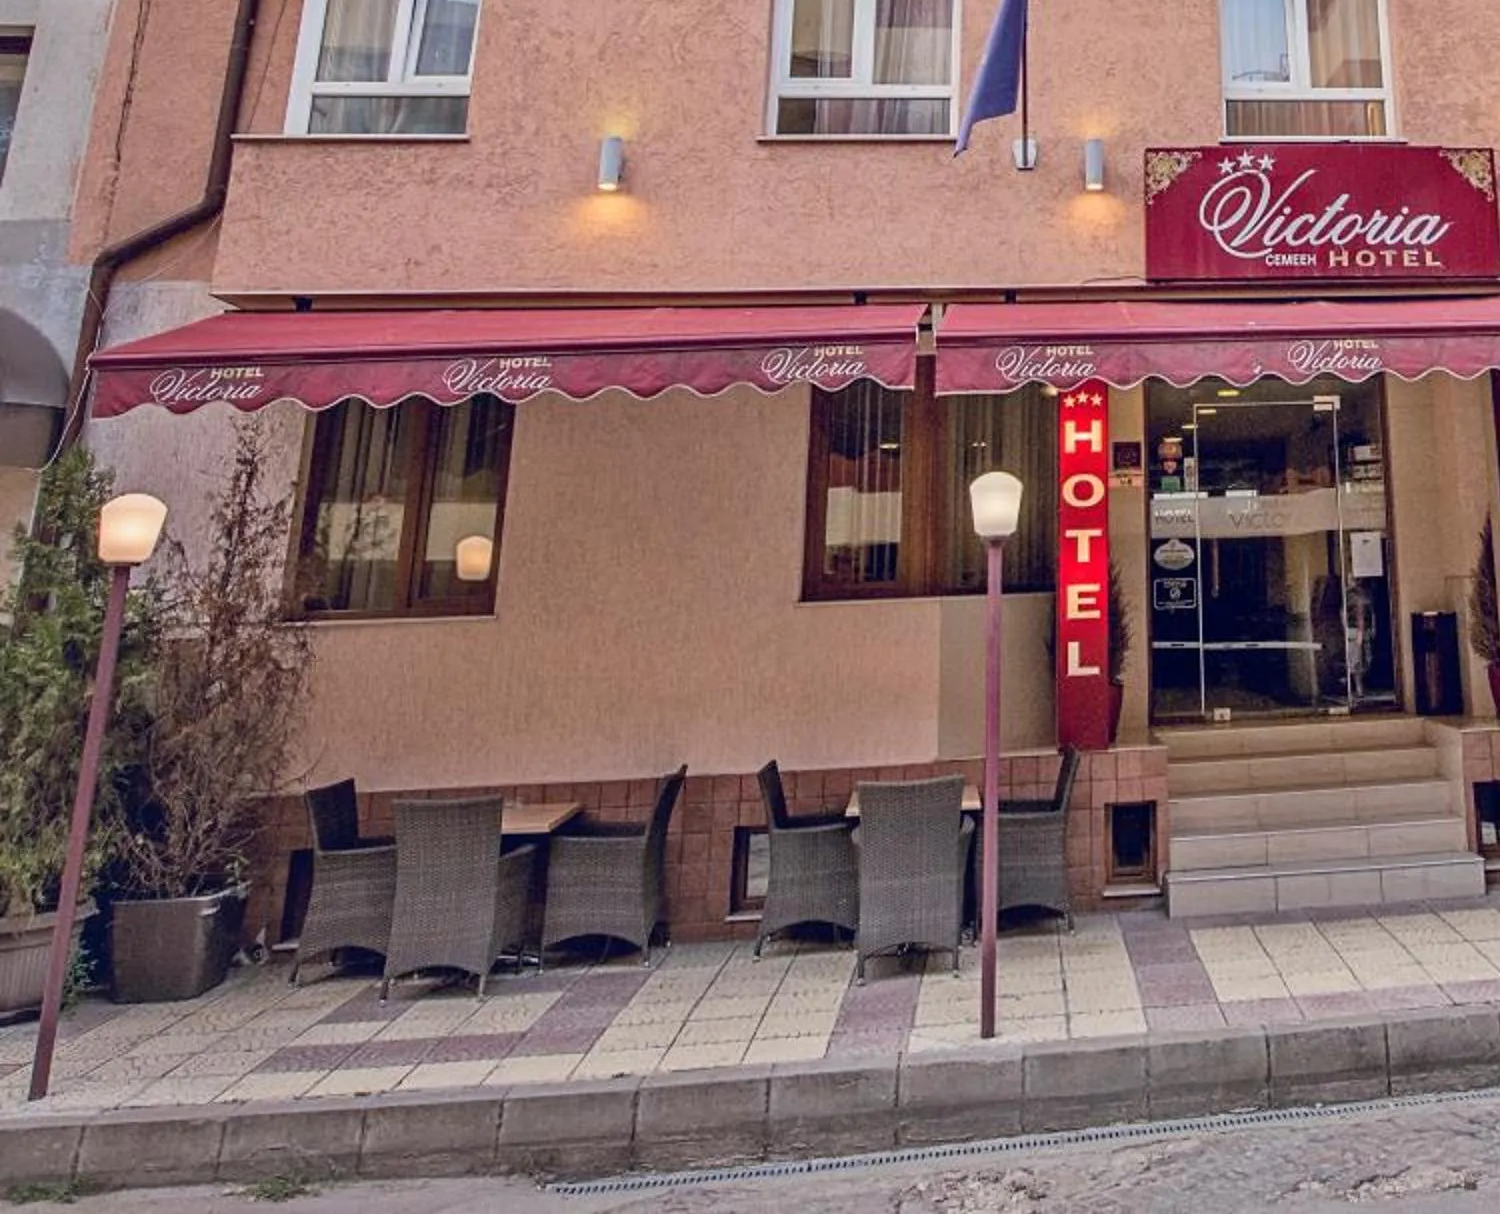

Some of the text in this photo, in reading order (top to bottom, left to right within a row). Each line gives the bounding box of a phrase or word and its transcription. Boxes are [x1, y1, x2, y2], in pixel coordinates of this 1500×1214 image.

[1200, 169, 1455, 258] Victoria
[1328, 250, 1443, 267] HOTEL
[500, 356, 552, 368] HOTEL
[761, 348, 866, 384] Victoria
[814, 345, 863, 356] HOTEL
[996, 346, 1096, 382] Victoria
[1046, 345, 1094, 356] HOTEL
[1287, 340, 1382, 374] Victoria
[150, 368, 263, 404] Victoria
[210, 367, 264, 378] HOTEL
[442, 358, 552, 394] Victoria
[1062, 420, 1104, 677] HOTEL
